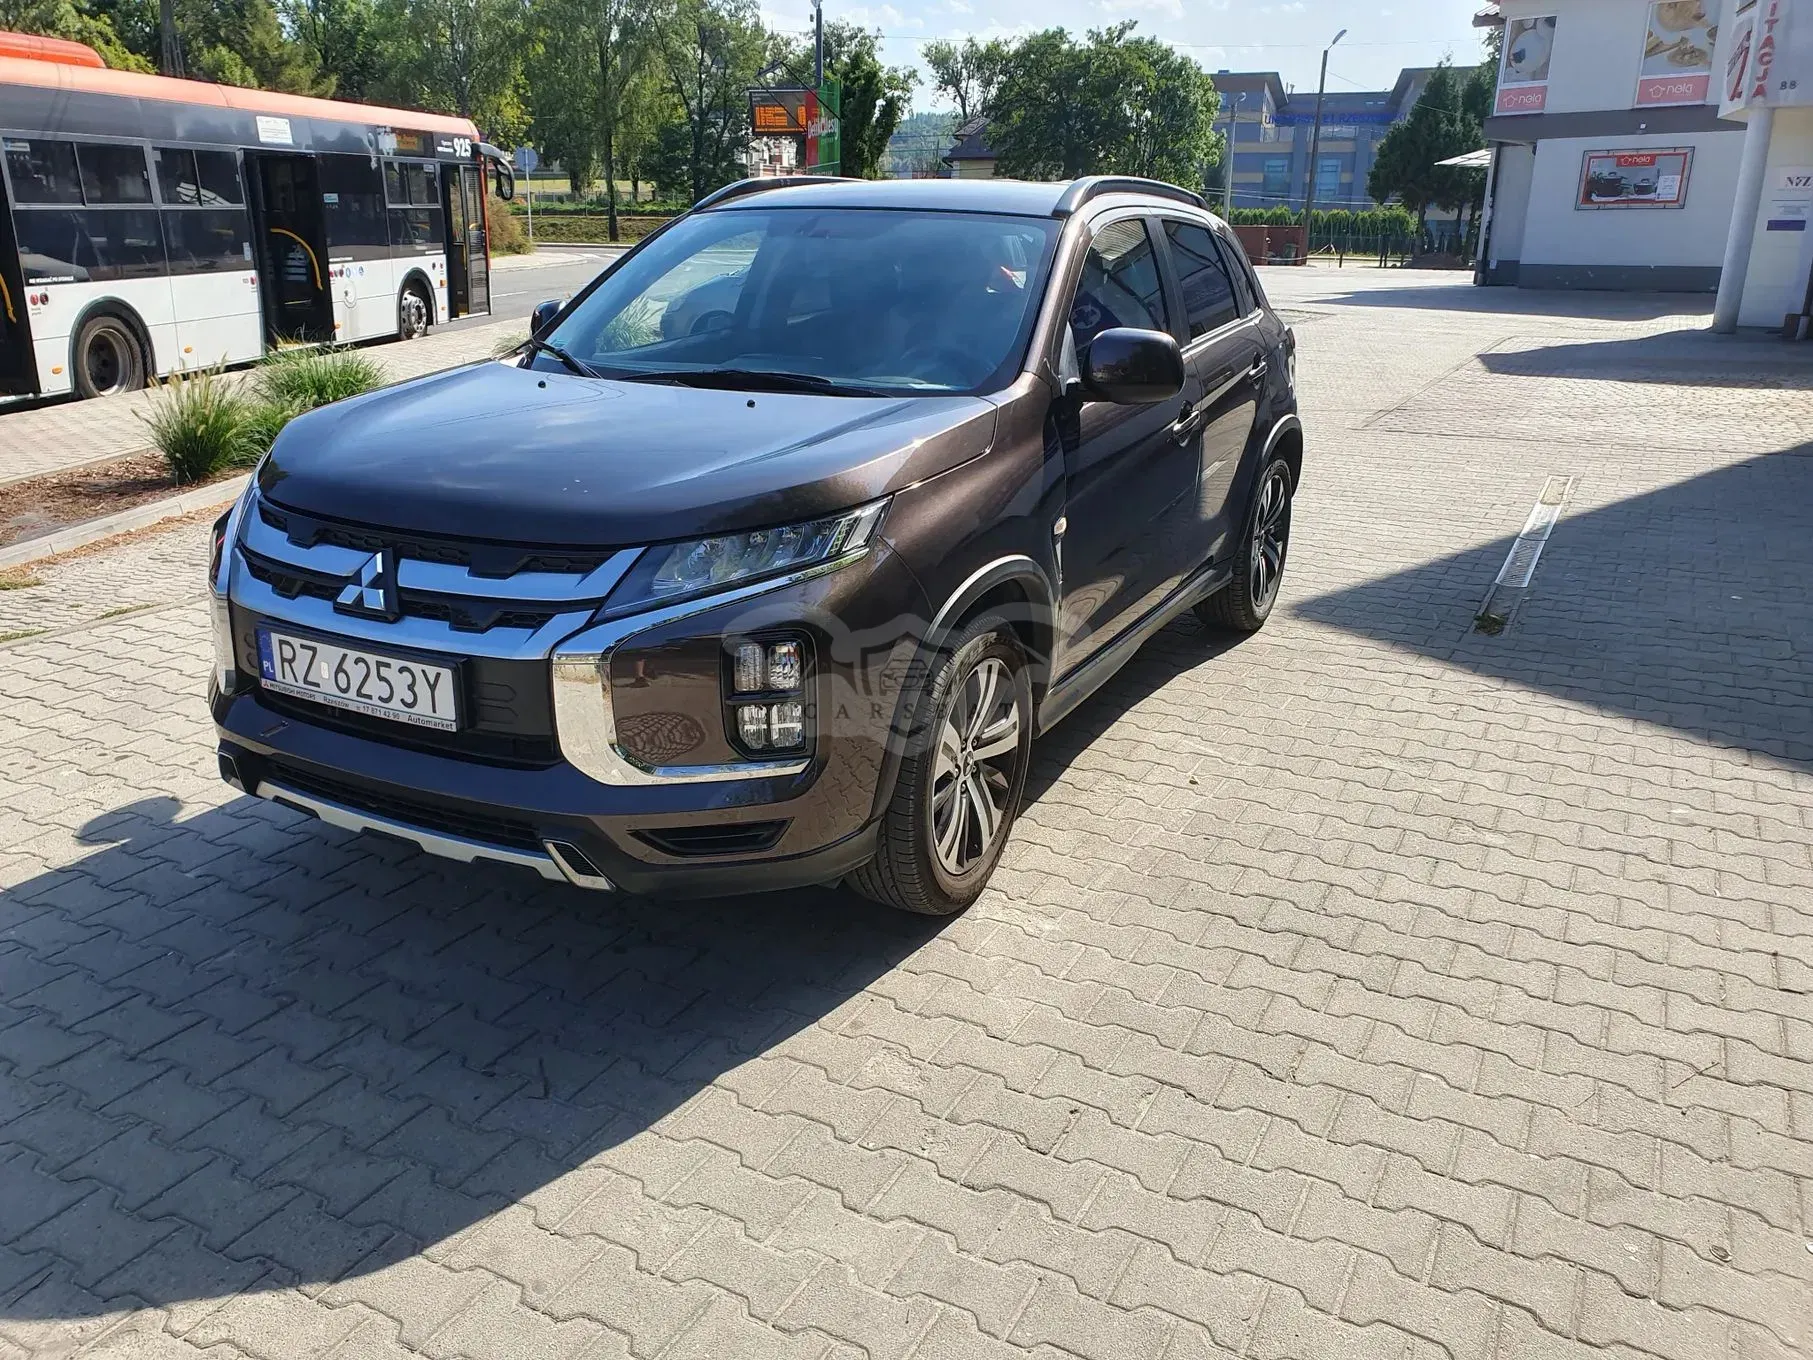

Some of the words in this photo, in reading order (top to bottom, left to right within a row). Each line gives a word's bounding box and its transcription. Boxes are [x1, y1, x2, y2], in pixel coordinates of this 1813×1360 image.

[1667, 84, 1693, 94] nela
[1518, 94, 1542, 104] nela
[453, 138, 472, 157] 925
[262, 660, 274, 673] PL
[278, 638, 321, 689] RZ
[334, 653, 442, 714] 6253Y
[407, 714, 454, 731] Automarket
